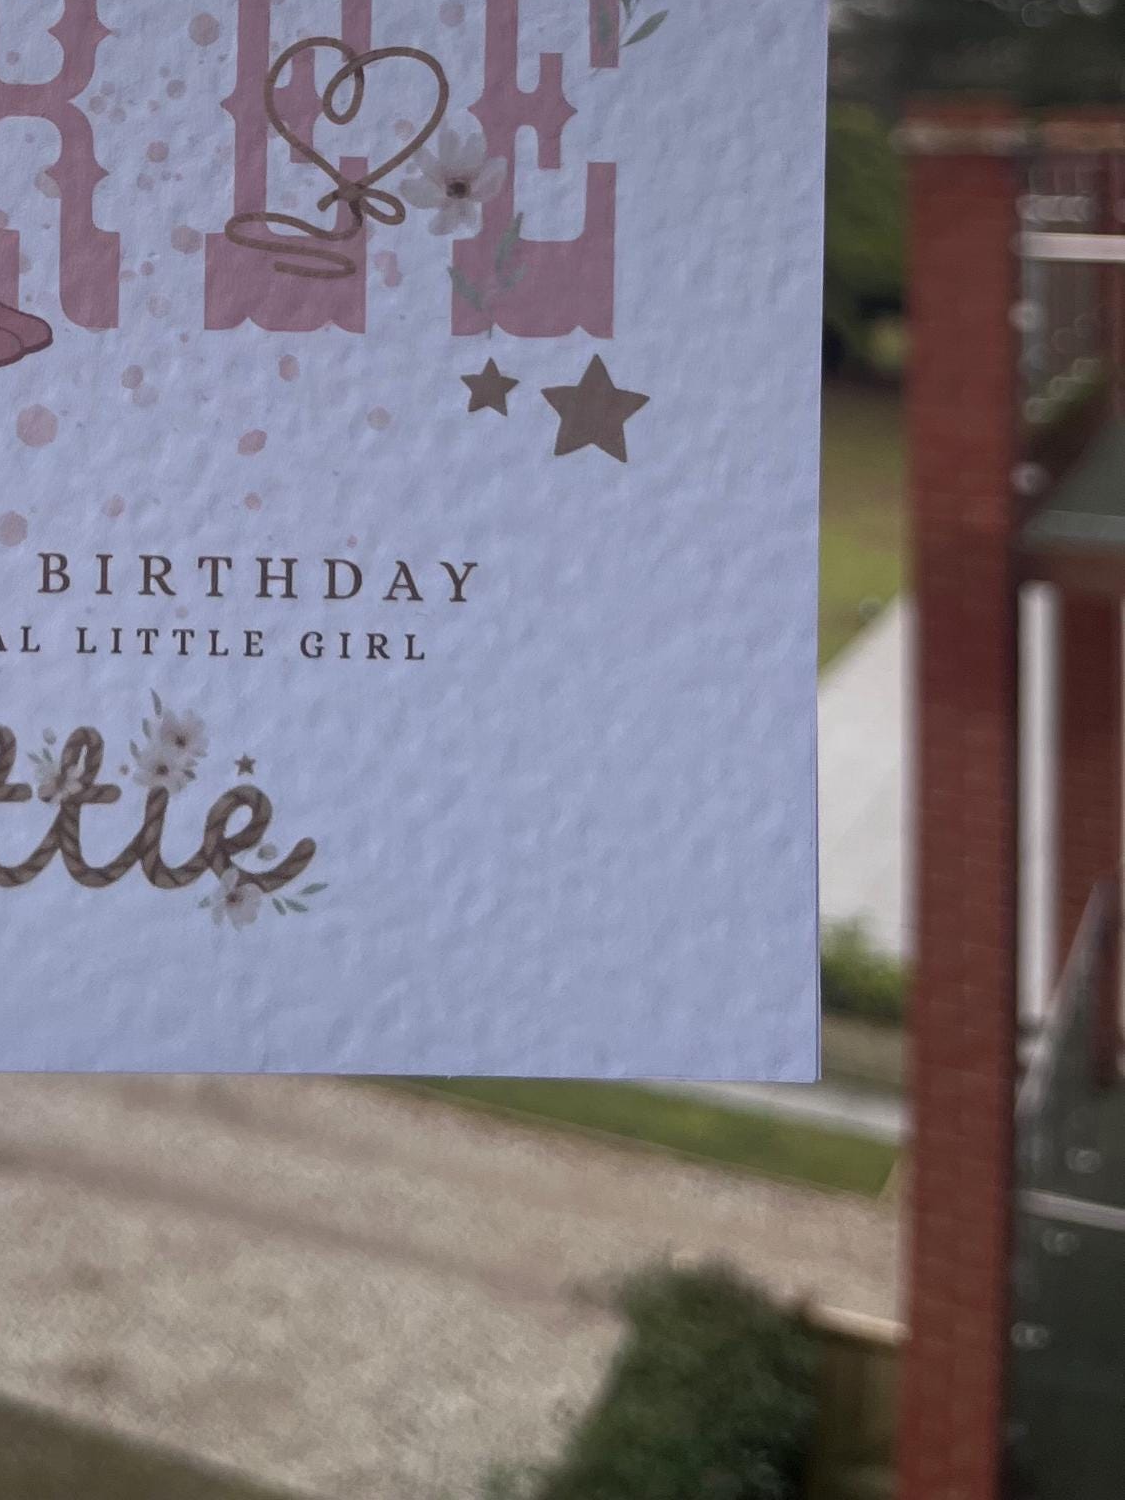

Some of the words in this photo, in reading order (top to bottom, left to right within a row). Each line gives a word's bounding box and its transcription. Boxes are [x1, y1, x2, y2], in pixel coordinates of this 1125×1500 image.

[37, 551, 482, 604] BIRTHDAY
[75, 626, 267, 659] LITTLE
[299, 631, 427, 662] GIRL
